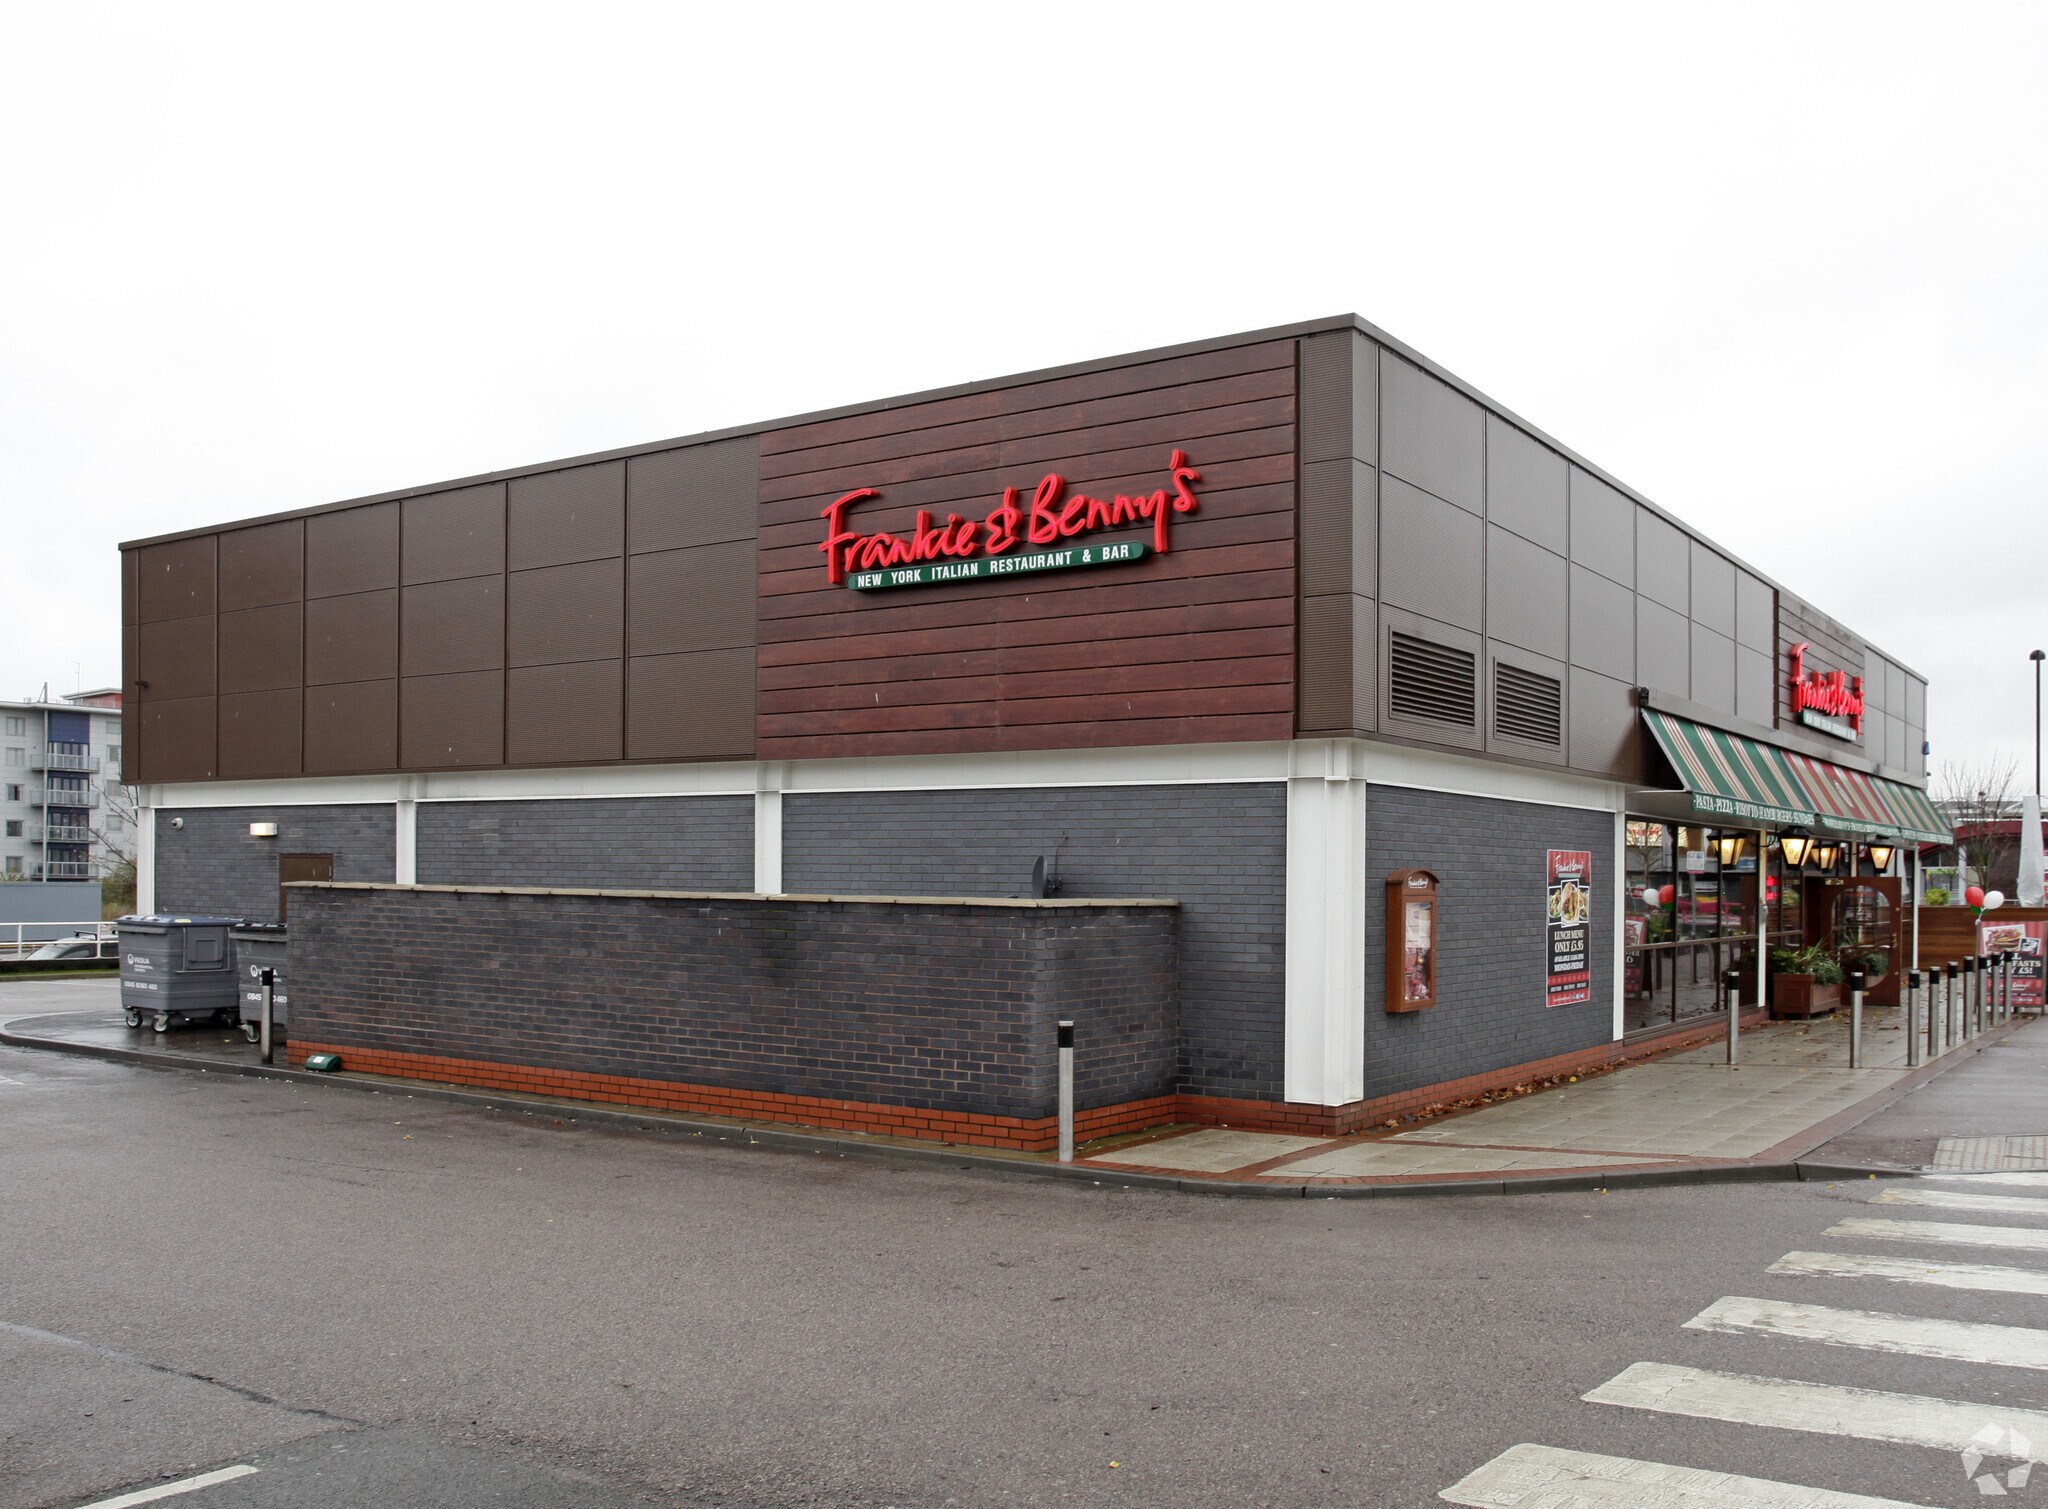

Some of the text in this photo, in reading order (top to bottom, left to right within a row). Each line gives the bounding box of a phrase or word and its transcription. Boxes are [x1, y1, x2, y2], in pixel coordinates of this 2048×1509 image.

[819, 448, 1201, 584] Frankie & Benny's
[857, 544, 1129, 588] NEW YORK ITALIAN RESTAURANT & BAR
[1695, 794, 1714, 810] PASTA
[1716, 797, 1734, 813] PIZZA
[1735, 800, 1759, 818] RISOTTO
[1554, 930, 1570, 940] LUNCH
[1554, 941, 1570, 953] ONLY
